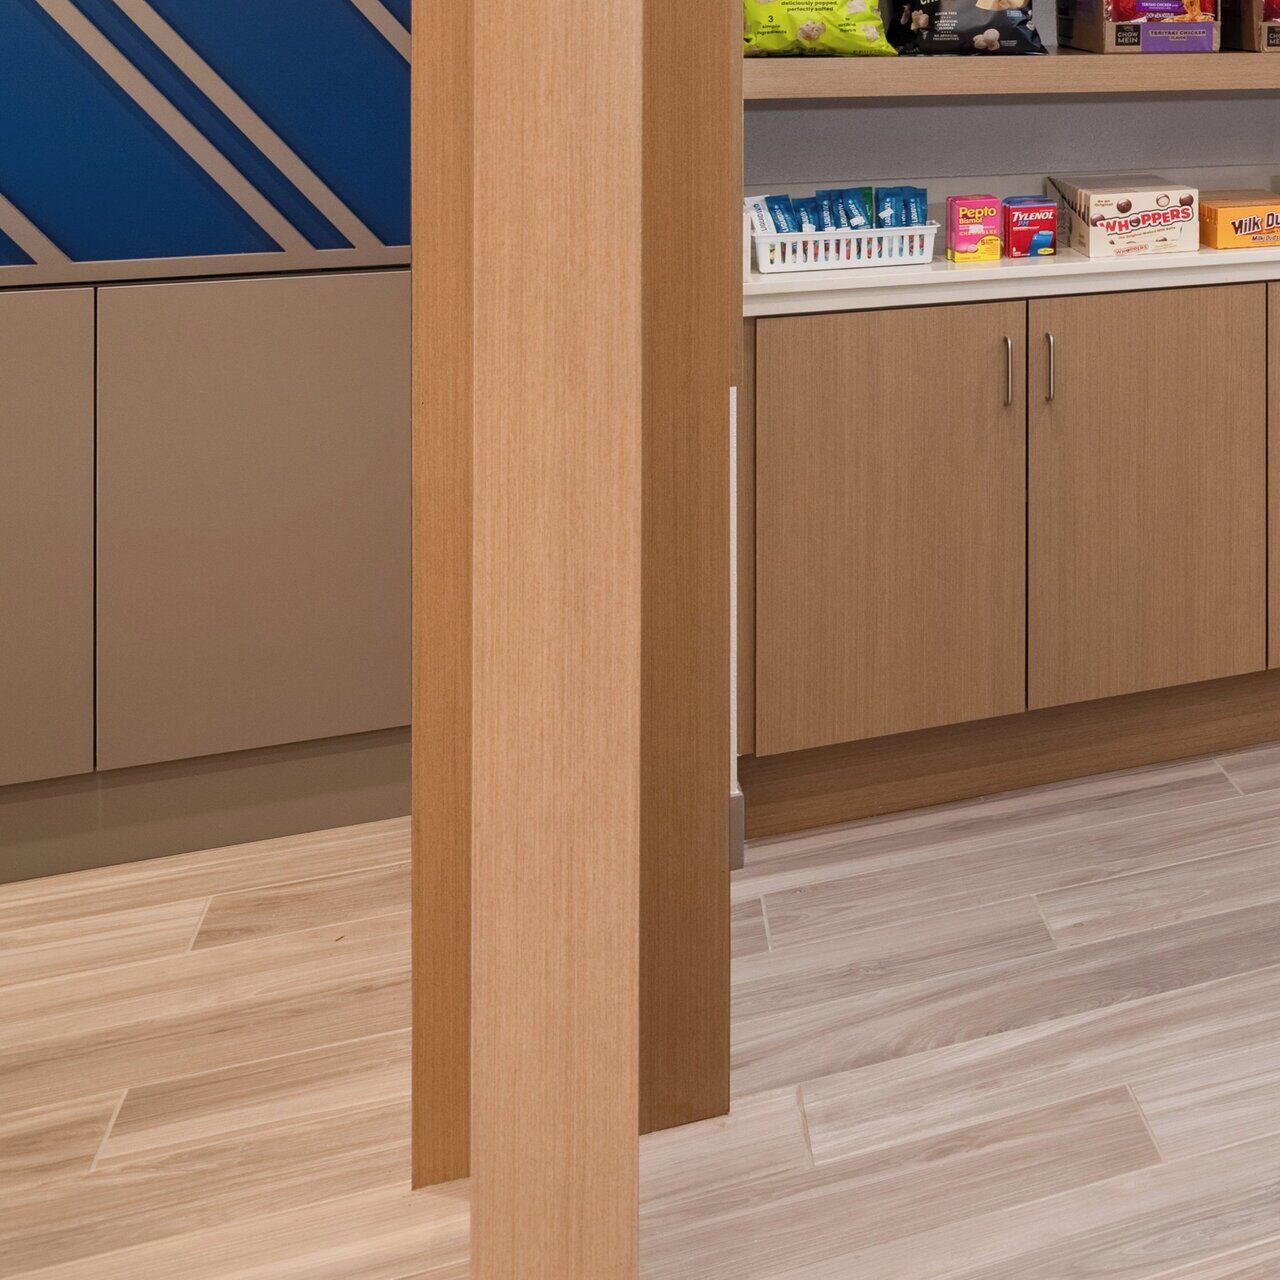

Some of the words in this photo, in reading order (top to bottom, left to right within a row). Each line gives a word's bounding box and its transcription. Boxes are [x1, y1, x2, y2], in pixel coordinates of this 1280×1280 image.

[768, 15, 774, 23] 3
[959, 207, 997, 219] Pepto
[1012, 211, 1054, 222] TYLENOL
[959, 217, 983, 225] Bismol
[1098, 206, 1191, 233] WHOPPERS
[1231, 216, 1262, 236] Milk
